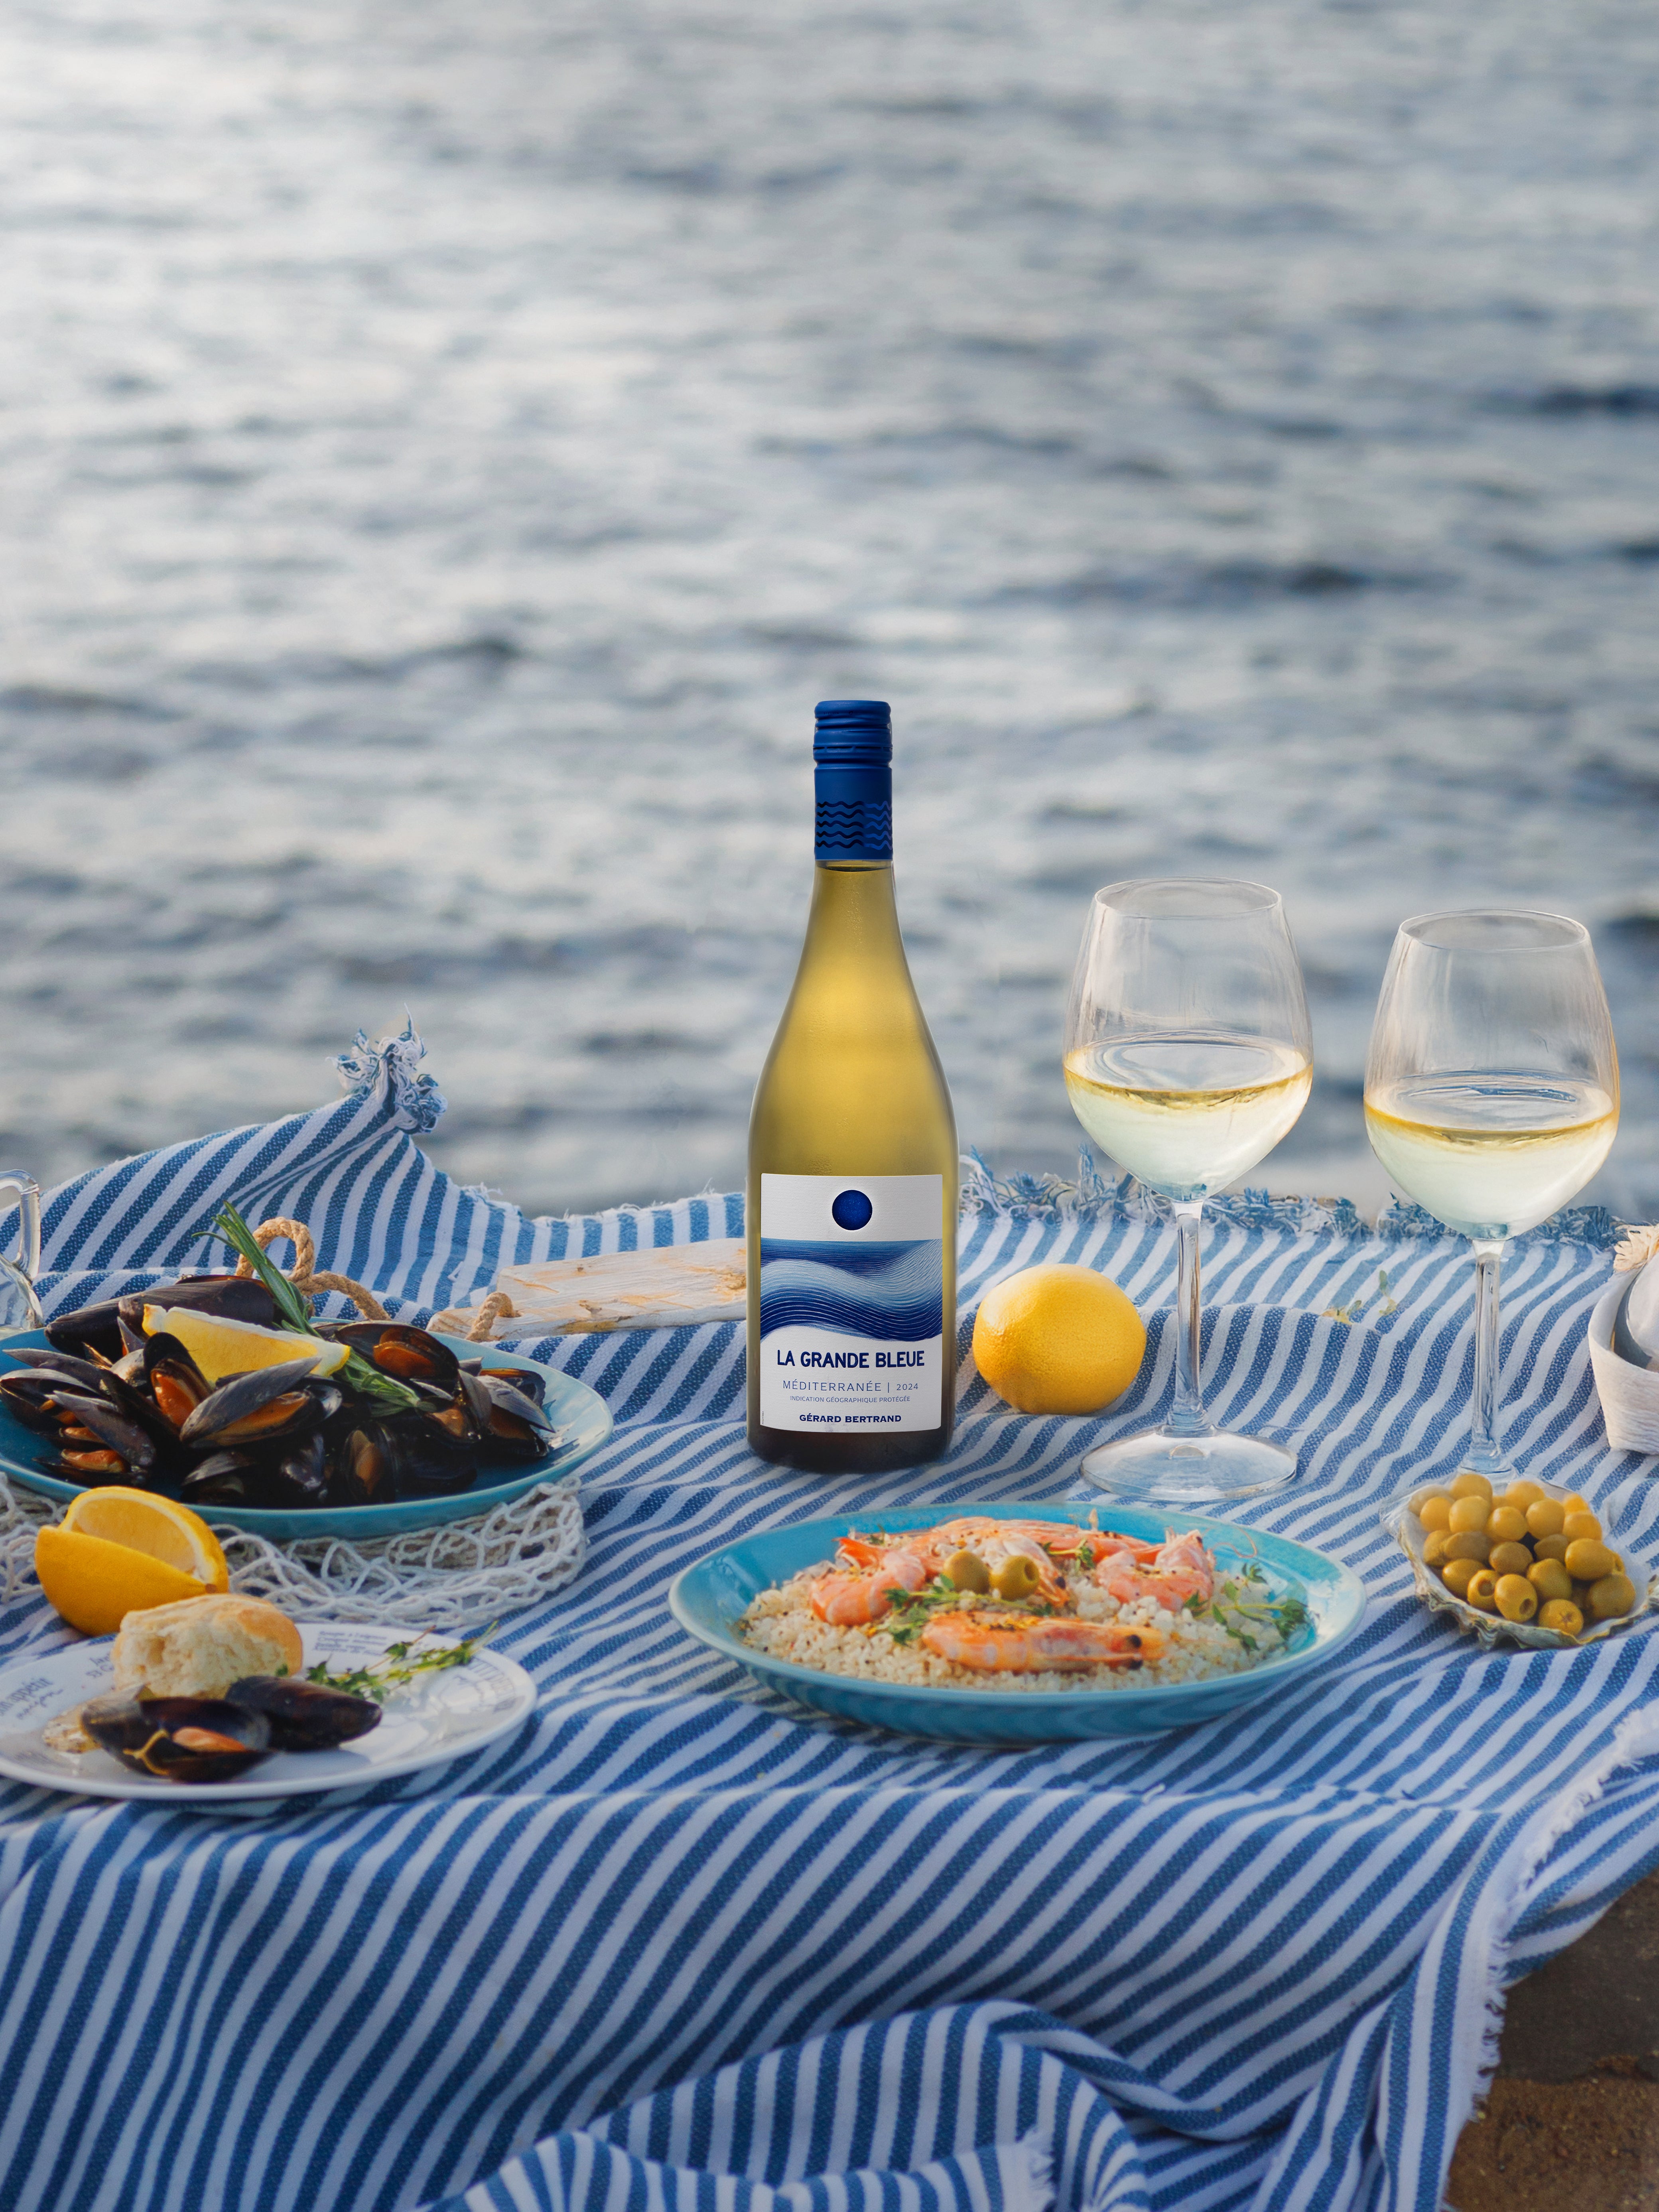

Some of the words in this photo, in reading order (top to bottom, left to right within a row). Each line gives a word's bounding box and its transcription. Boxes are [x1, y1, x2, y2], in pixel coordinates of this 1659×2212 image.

[777, 1349, 795, 1366] LA
[800, 1351, 869, 1368] GRANDE
[875, 1350, 925, 1368] BLEUE
[783, 1379, 881, 1391] MÉDITERRANÉE
[799, 1413, 841, 1422] GÉRARD
